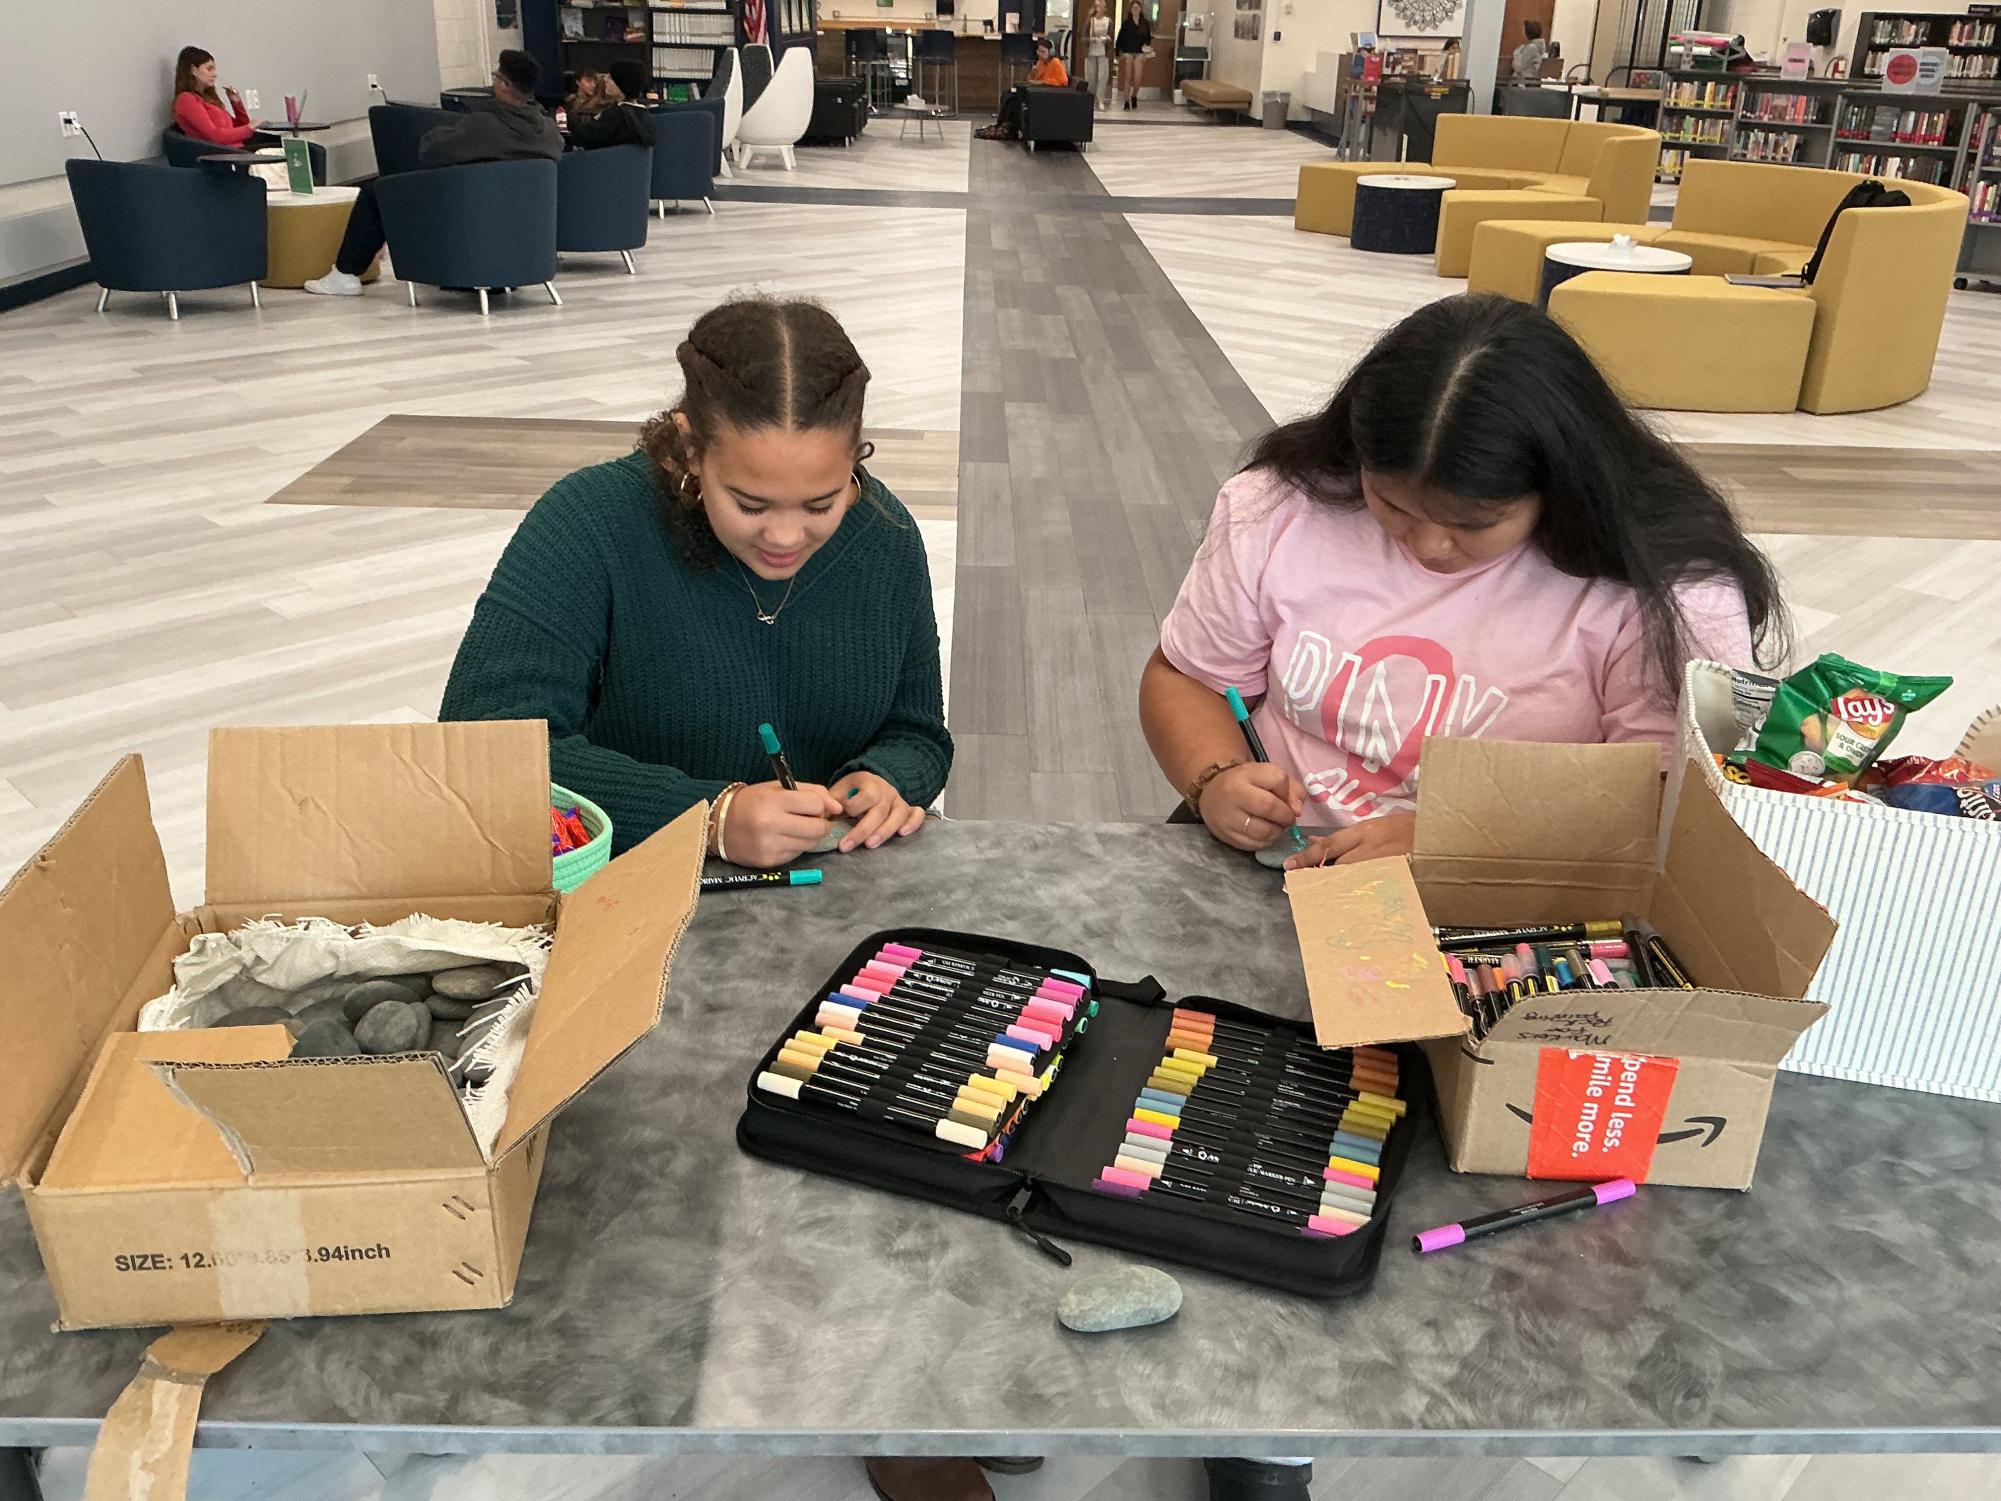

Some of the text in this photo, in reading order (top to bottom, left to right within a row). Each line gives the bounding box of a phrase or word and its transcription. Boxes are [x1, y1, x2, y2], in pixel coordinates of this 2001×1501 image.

[701, 873, 758, 885] ACRYLIC MARK
[1571, 1054, 1612, 1158] mile more.
[1601, 1056, 1647, 1153] pend less.
[114, 1252, 174, 1272] SIZE:
